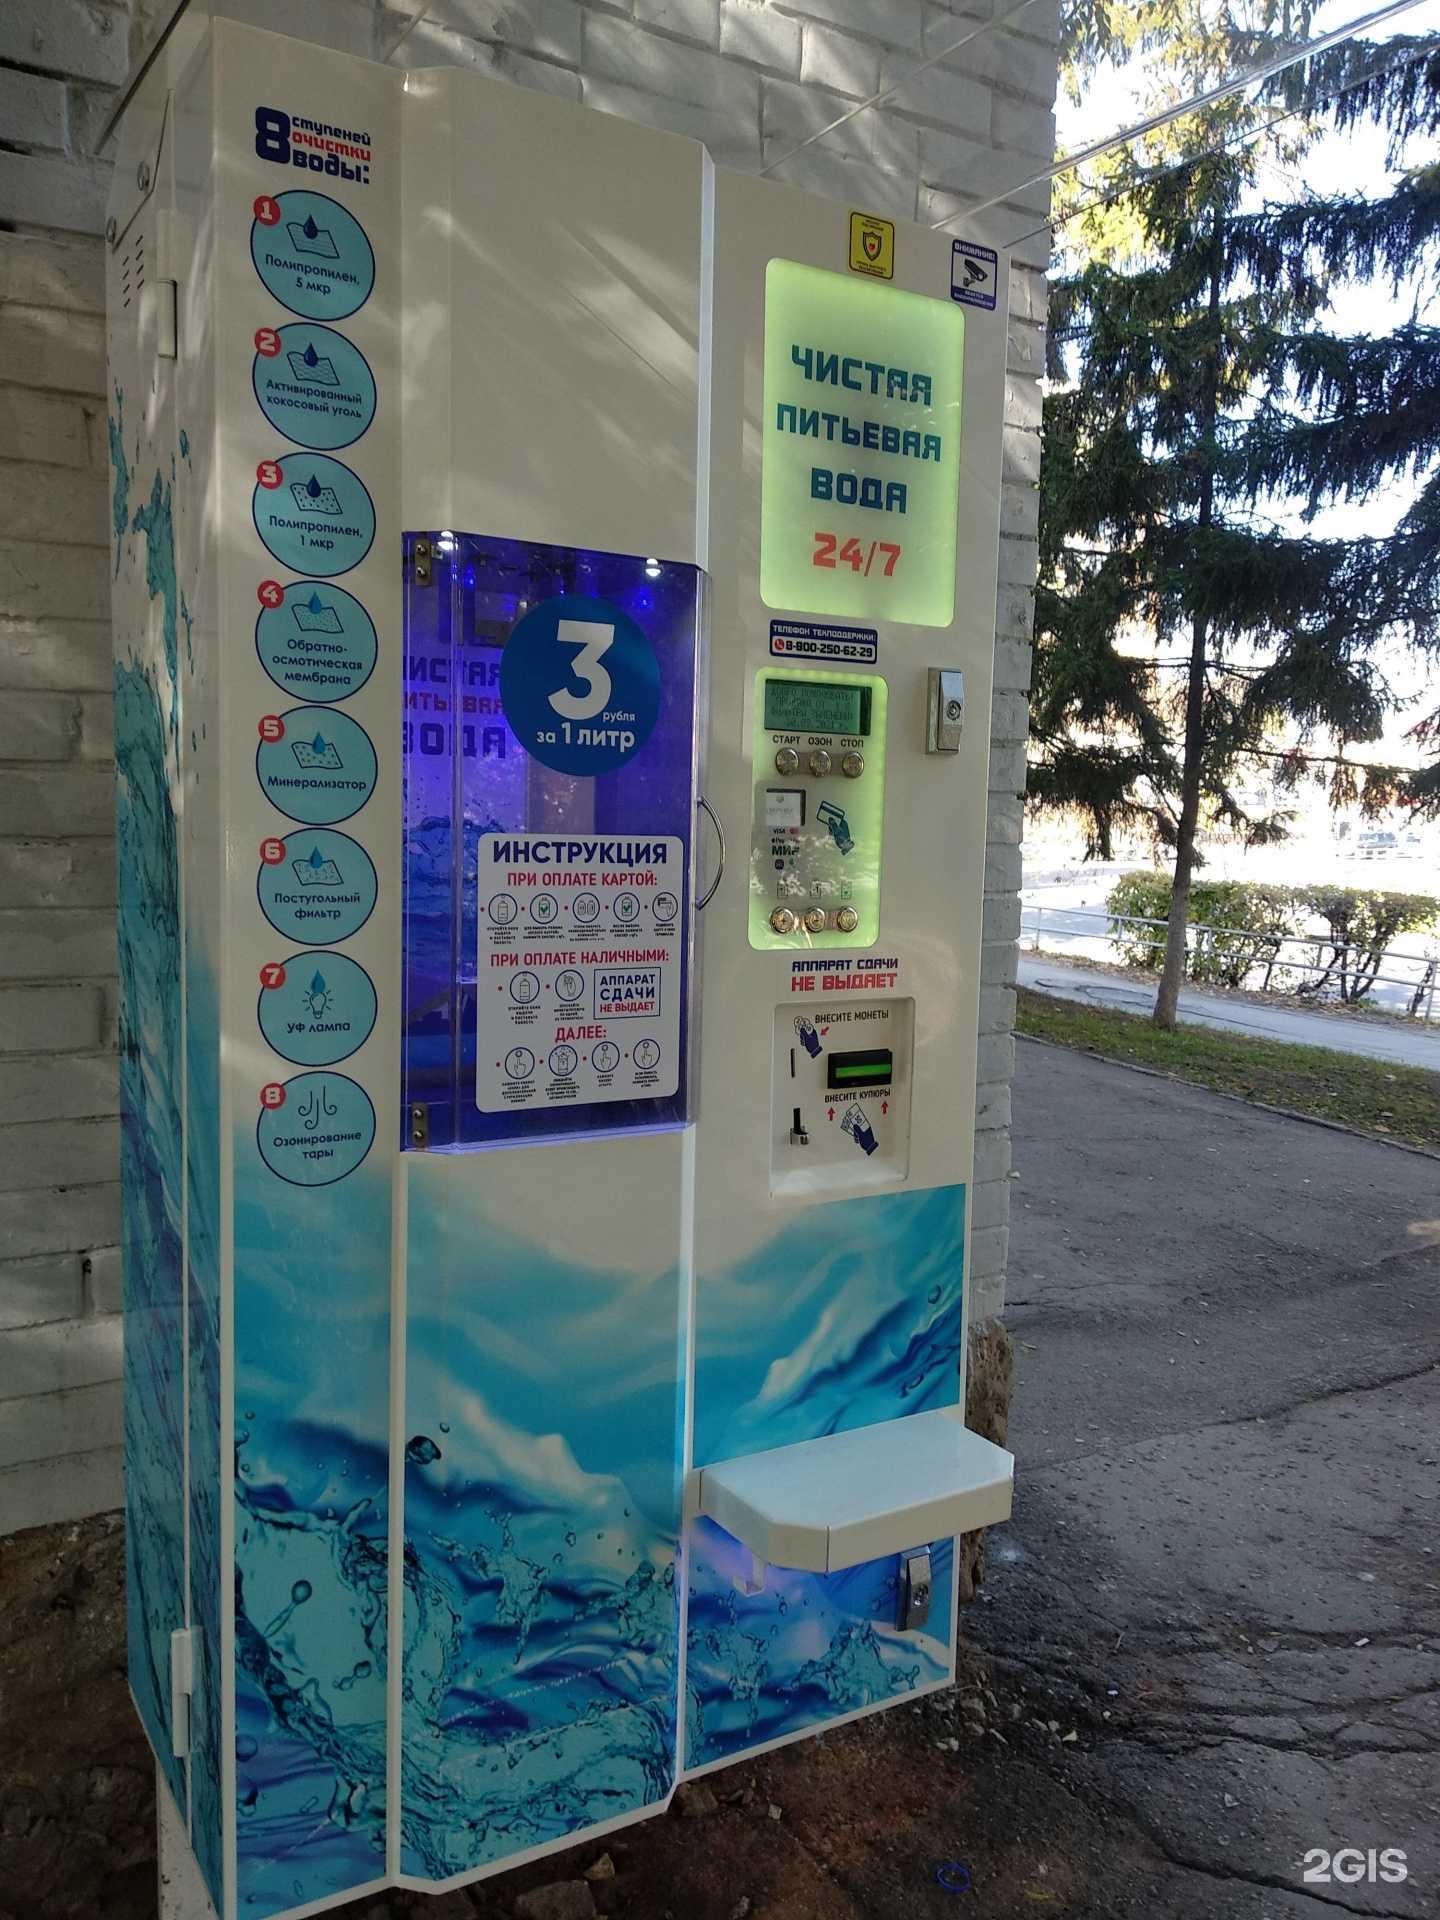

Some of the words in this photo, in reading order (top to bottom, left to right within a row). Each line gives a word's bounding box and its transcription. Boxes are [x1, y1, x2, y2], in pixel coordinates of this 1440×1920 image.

[255, 106, 291, 164] 8
[292, 116, 371, 146] ступеней
[292, 131, 371, 162] очистки
[292, 149, 370, 184] воды:
[260, 201, 272, 220] 1
[265, 253, 360, 285] Полипропилен,
[296, 277, 303, 288] 5
[306, 281, 332, 296] мкр
[260, 331, 275, 352] 2
[791, 344, 932, 406] ЧИСТАЯ
[266, 379, 362, 405] Активированный
[267, 395, 330, 413] кокосовый
[332, 406, 362, 418] уголь
[776, 402, 942, 463] ПИТЬЕВАЯ
[261, 464, 277, 483] 3
[810, 467, 908, 514] ВОДА
[269, 515, 363, 538] Полипропилен,
[301, 535, 305, 546] 1
[309, 538, 334, 551] мкр
[813, 532, 901, 577] 24/7
[262, 585, 279, 603] 4
[773, 624, 810, 636] ТЕЛЕФОН
[287, 639, 348, 653] Обратно-
[785, 640, 873, 657] 8-800-250-62-29
[272, 655, 362, 670] осмотическая
[547, 619, 615, 720] 3
[284, 671, 351, 685] мембрана
[602, 711, 635, 723] рубля
[263, 719, 279, 737] 5
[536, 729, 556, 744] за
[561, 722, 572, 744] 1
[576, 727, 635, 752] литр
[772, 735, 801, 745] СТАРТ
[808, 736, 833, 746] ОЗОН
[840, 738, 864, 748] СТОП
[268, 776, 367, 792] Минерализатор
[493, 840, 667, 867] ИНСТРУКЦИЯ
[507, 872, 537, 886] ПРИ
[542, 872, 597, 886] ОПЛАТЕ
[601, 870, 658, 886] КАРТОЙ:
[274, 892, 360, 905] Постугольный
[294, 907, 341, 921] фильтр
[490, 953, 519, 967] ПРИ
[523, 951, 576, 965] ОПЛАТЕ
[580, 949, 669, 964] НАЛИЧНЫМИ:
[792, 959, 852, 972] АППАРАТ
[857, 958, 898, 971] СДАЧИ
[265, 967, 280, 985] 7
[600, 974, 656, 987] АППАРАТ
[791, 975, 815, 992] НЕ
[822, 973, 897, 991] ВЫДАЕТ
[600, 987, 655, 1002] СДАЧИ
[600, 1002, 613, 1013] НЕ
[615, 1001, 655, 1013] ВЫДАЕТ
[815, 1012, 852, 1024] ВНЕСИТЕ
[854, 1010, 889, 1021] МОНЕТЫ
[309, 1022, 351, 1033] лампа
[555, 1025, 607, 1043] ДАЛЕЕ:
[824, 1092, 857, 1103] ВНЕСИТЕ
[859, 1088, 891, 1099] КУПЮРЫ
[273, 1132, 362, 1148] Озонирование
[302, 1149, 334, 1160] тары
